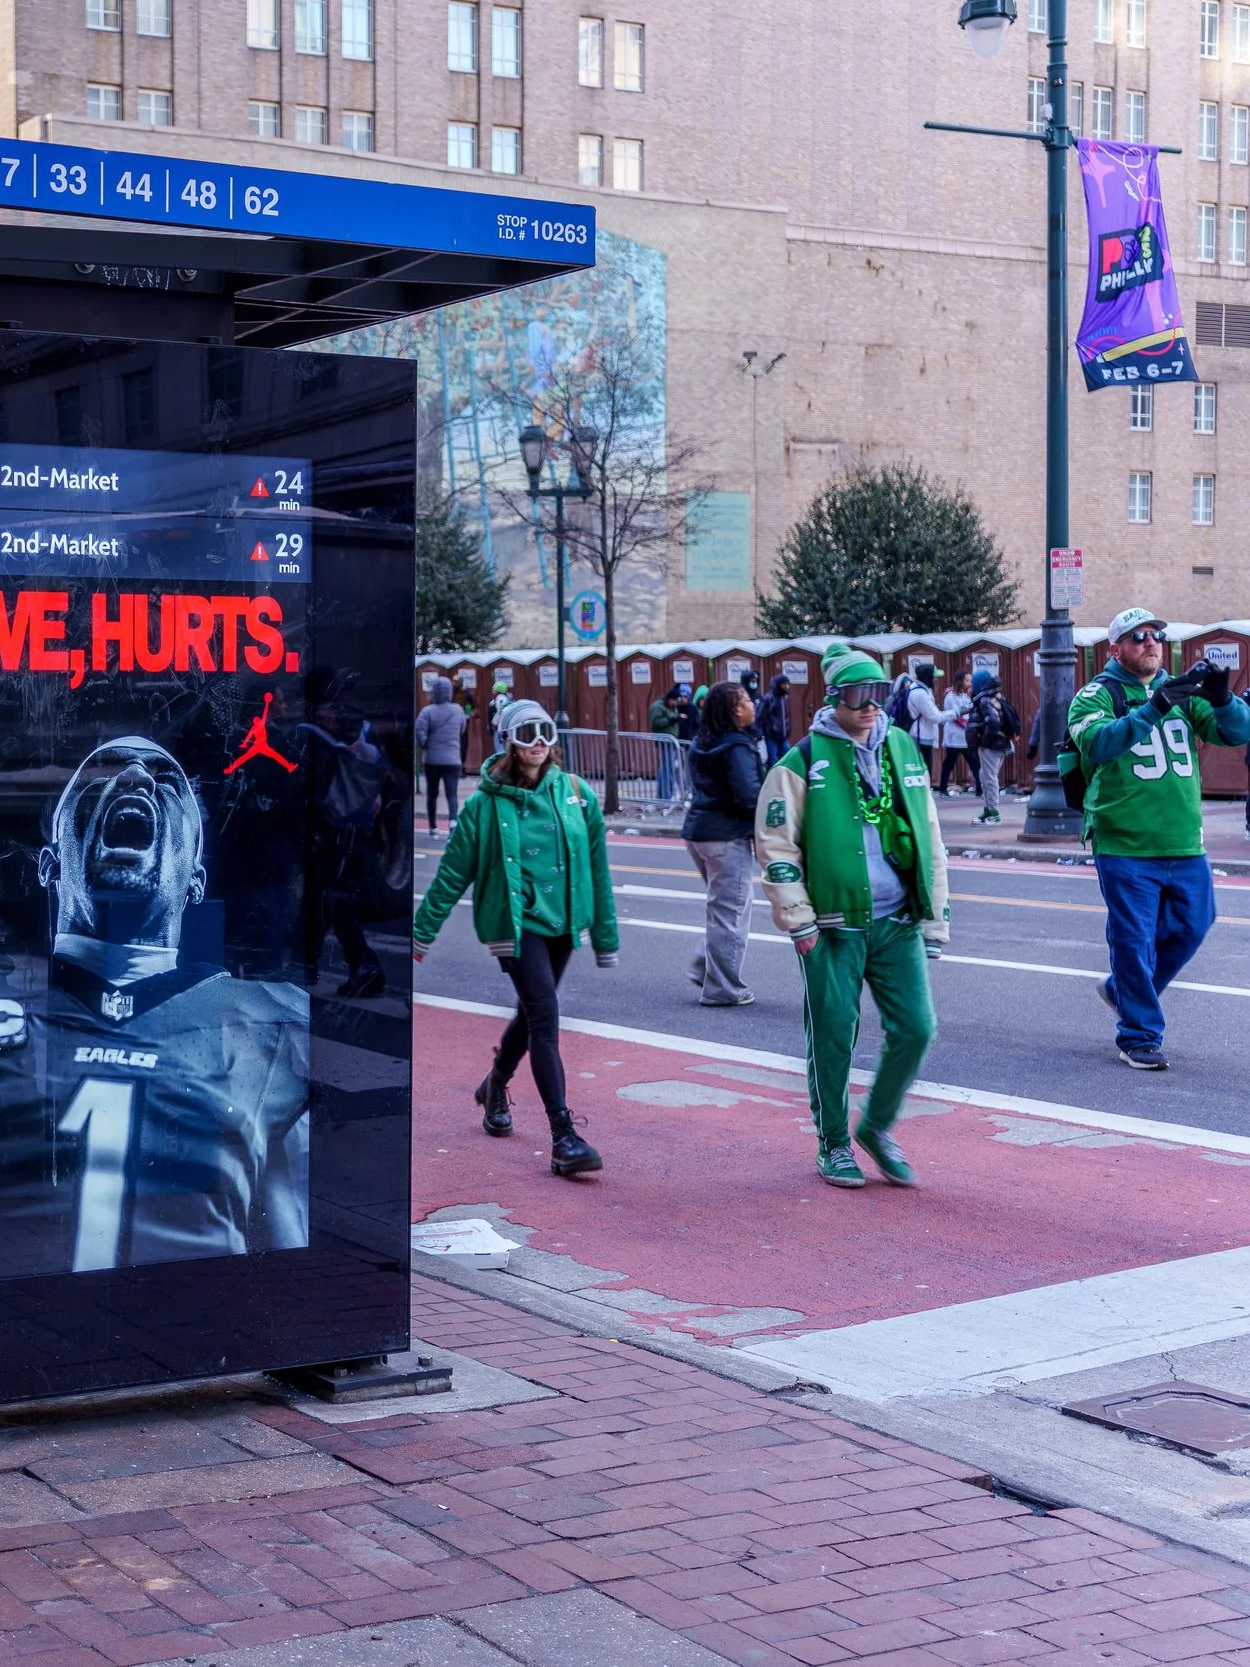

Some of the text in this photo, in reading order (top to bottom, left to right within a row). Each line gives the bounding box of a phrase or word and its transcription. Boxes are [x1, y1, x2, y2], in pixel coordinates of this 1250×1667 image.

[49, 163, 87, 195] 33
[116, 171, 153, 202] 44
[181, 178, 217, 209] 48
[244, 186, 279, 216] 62
[497, 214, 527, 228] STOP
[531, 219, 588, 244] 10263
[499, 228, 526, 240] I.D. #
[1100, 257, 1154, 292] PHILLY
[1101, 361, 1184, 381] FEB 6-7
[0, 465, 119, 491] 2nd-Market
[274, 470, 304, 495] 24
[279, 498, 300, 511] min
[0, 532, 119, 557] 2nd-Market
[275, 533, 303, 557] 29
[279, 561, 300, 574] min
[92, 593, 299, 674] HURTS.
[1208, 650, 1238, 660] United
[1130, 718, 1193, 780] 99
[74, 1046, 160, 1069] EAGLES
[58, 1079, 133, 1273] 1
